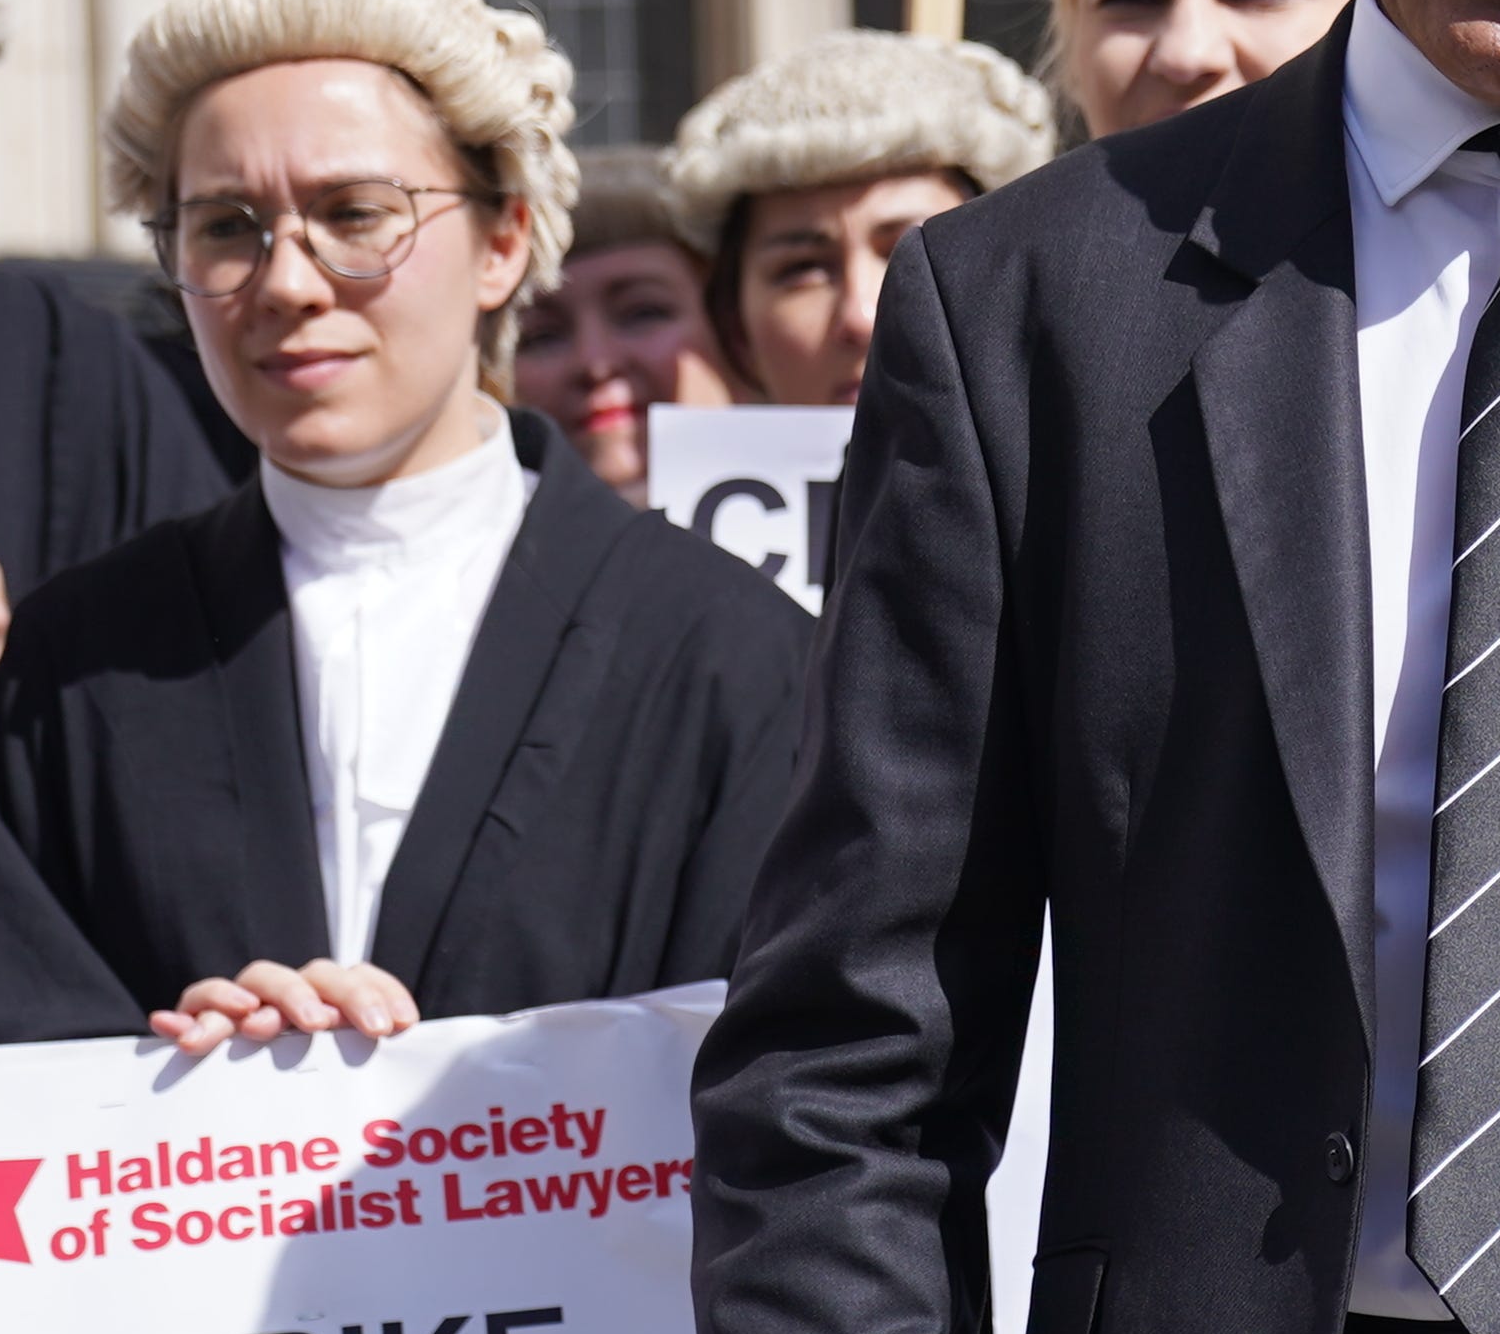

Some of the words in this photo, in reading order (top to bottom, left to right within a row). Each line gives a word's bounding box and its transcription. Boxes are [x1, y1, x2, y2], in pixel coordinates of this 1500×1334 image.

[66, 1128, 340, 1200] Haldane
[362, 1103, 606, 1167] Society
[50, 1208, 111, 1263] of
[129, 1180, 422, 1251] Socialist
